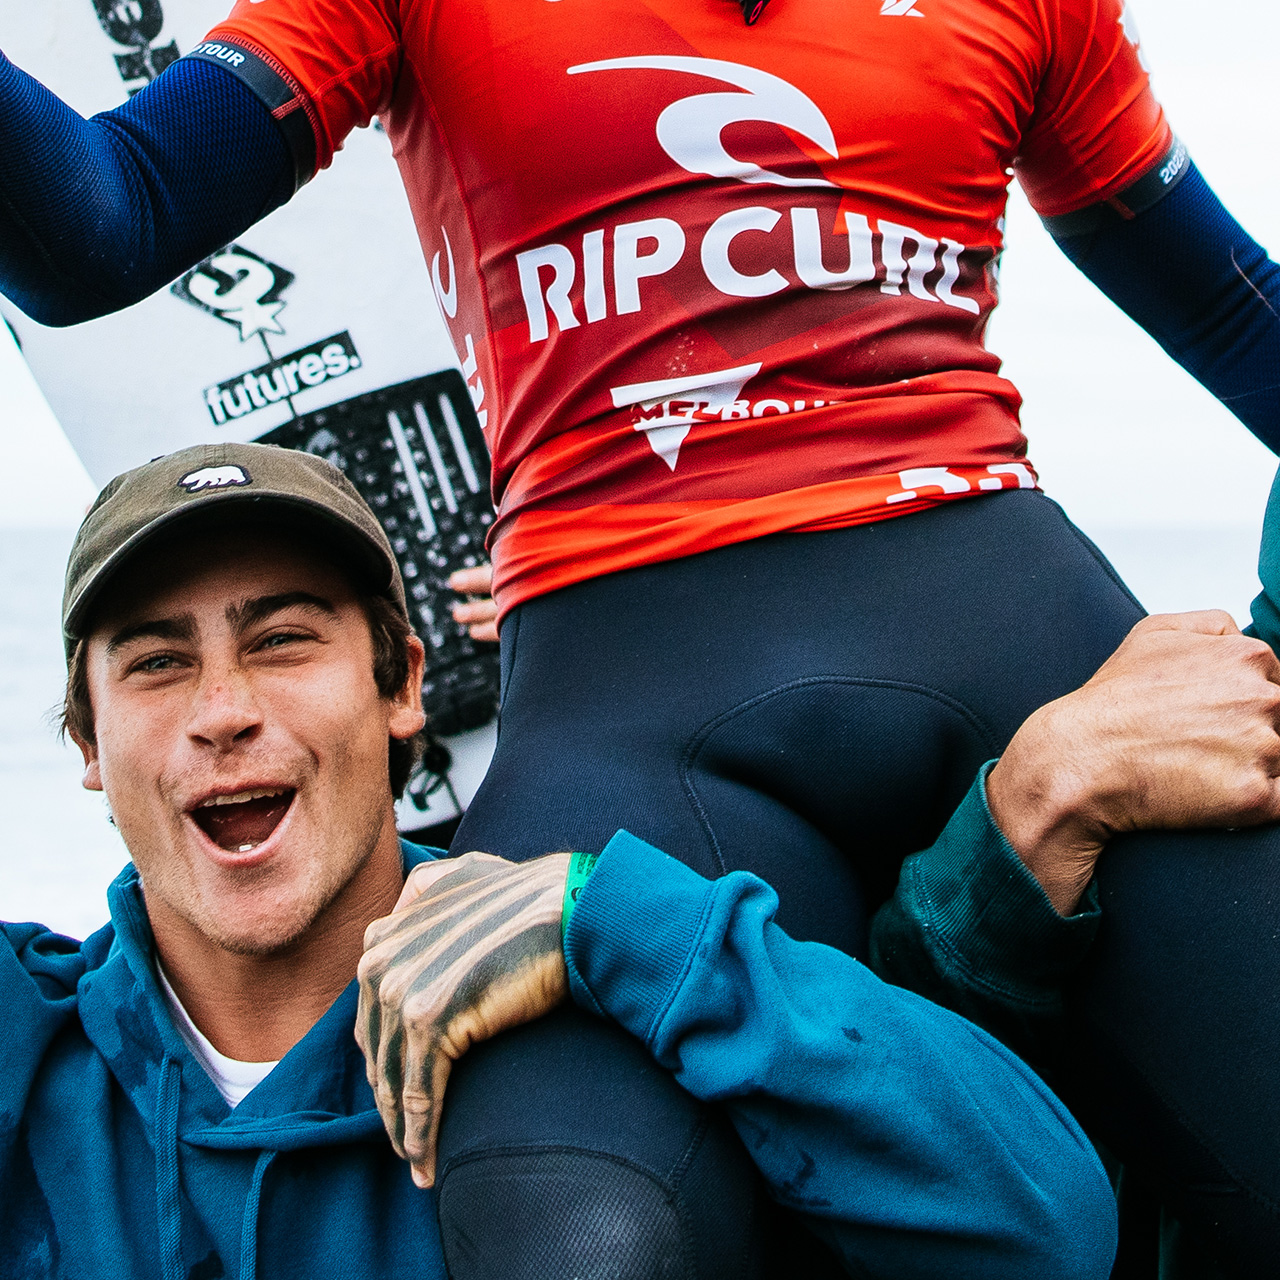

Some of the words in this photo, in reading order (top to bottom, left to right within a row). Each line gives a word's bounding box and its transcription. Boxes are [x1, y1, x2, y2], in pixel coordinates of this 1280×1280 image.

[198, 43, 246, 67] TOUR
[516, 217, 686, 343] RIP
[700, 206, 979, 315] CURL
